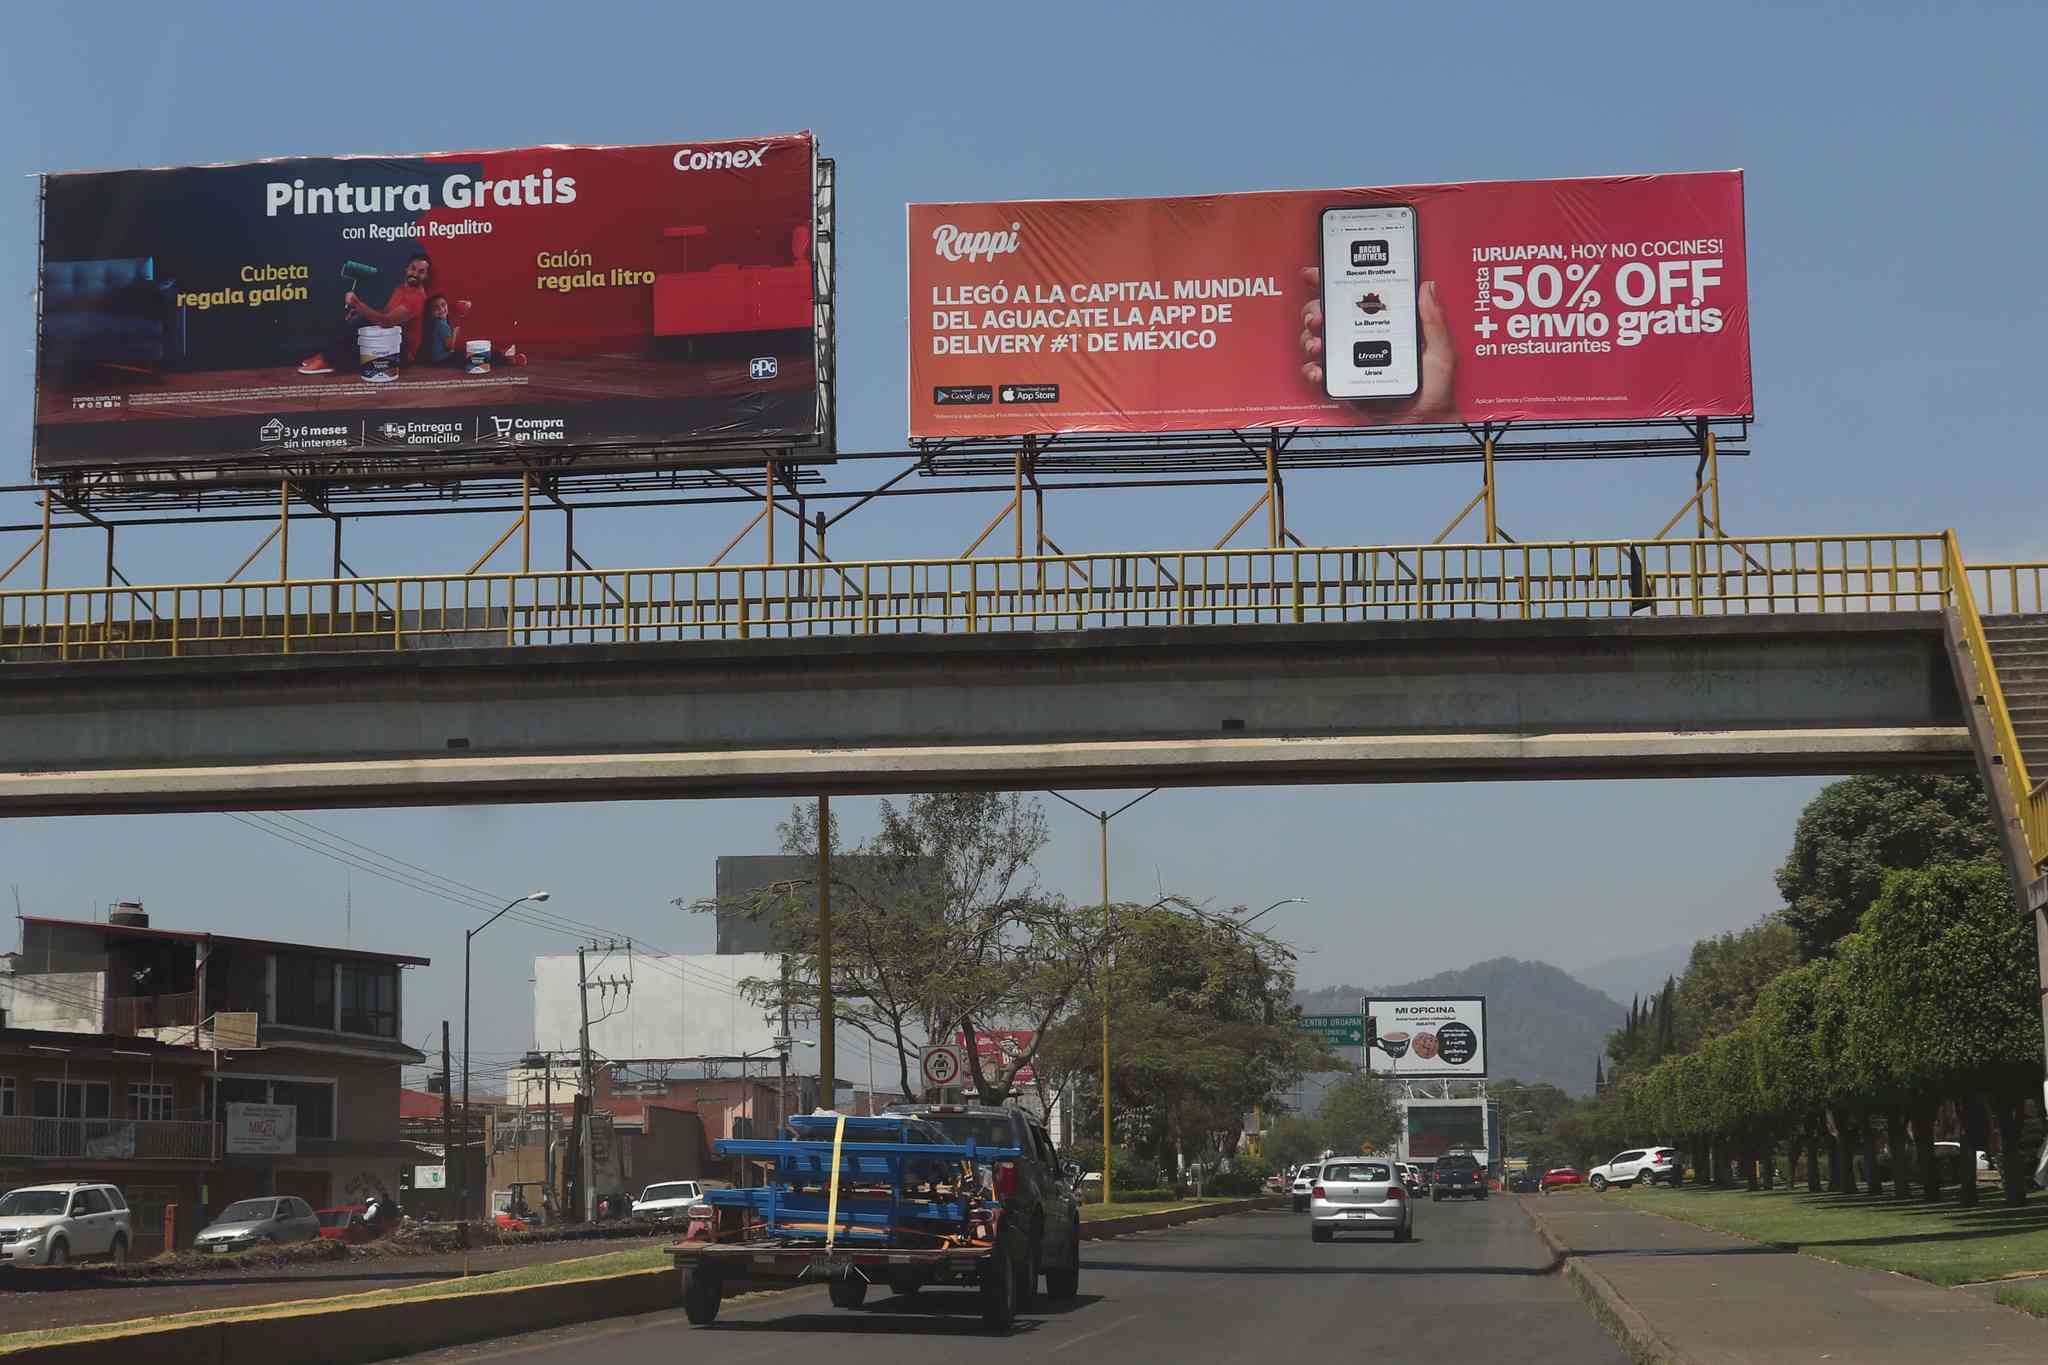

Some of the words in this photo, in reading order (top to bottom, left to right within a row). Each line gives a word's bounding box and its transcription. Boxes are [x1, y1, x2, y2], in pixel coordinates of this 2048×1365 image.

[673, 145, 769, 171] Comex
[266, 179, 431, 216] Pintura
[442, 168, 577, 208] Gratis
[343, 226, 365, 240] con
[369, 221, 425, 242] Regalón
[429, 219, 492, 239] Regalitro
[932, 222, 1021, 263] Rappi
[1472, 244, 1568, 262] ¡URUAPAN,
[1571, 243, 1607, 259] HOY
[1611, 242, 1637, 257] NO
[1641, 239, 1723, 256] COCINES!
[537, 249, 592, 268] Galón
[241, 264, 308, 282] Cubeta
[537, 270, 606, 292] regala
[611, 268, 656, 286] litro
[932, 280, 1009, 305] LLEGÓ
[1013, 285, 1030, 304] A
[1036, 284, 1065, 303] LA
[1071, 280, 1169, 302] CAPITAL
[1174, 277, 1282, 300] MUNDIAL
[1475, 267, 1490, 312] Hasta
[1491, 264, 1601, 310] 50%
[1615, 259, 1723, 306] OFF
[176, 288, 245, 309] regala
[249, 283, 308, 306] galón
[932, 310, 977, 330] DEL
[982, 307, 1108, 329] AGUACATE
[1113, 306, 1143, 327] LA
[1149, 304, 1196, 325] APP
[1201, 303, 1233, 323] DE
[1506, 301, 1609, 338] envío
[1616, 297, 1723, 346] gratis
[932, 334, 1045, 355] DELIVERY
[1087, 332, 1119, 352] DE
[1123, 326, 1217, 350] MÉXICO
[1475, 342, 1497, 356] en
[1501, 338, 1611, 355] restaurantes
[752, 360, 776, 376] PPG
[951, 390, 975, 401] Google
[1017, 391, 1033, 401] App
[1034, 390, 1056, 400] Store
[284, 426, 291, 437] 3
[292, 429, 300, 439] y
[301, 425, 308, 435] 6
[309, 425, 348, 435] meses
[407, 422, 452, 435] Entrega
[455, 423, 462, 431] a
[515, 418, 564, 431] Compra
[515, 431, 530, 441] en
[532, 428, 564, 440] línea
[284, 440, 299, 449] sin
[301, 438, 348, 448] intereses
[407, 433, 460, 444] domicilio
[1395, 1007, 1408, 1015] MI
[1410, 1006, 1455, 1014] OFICINA
